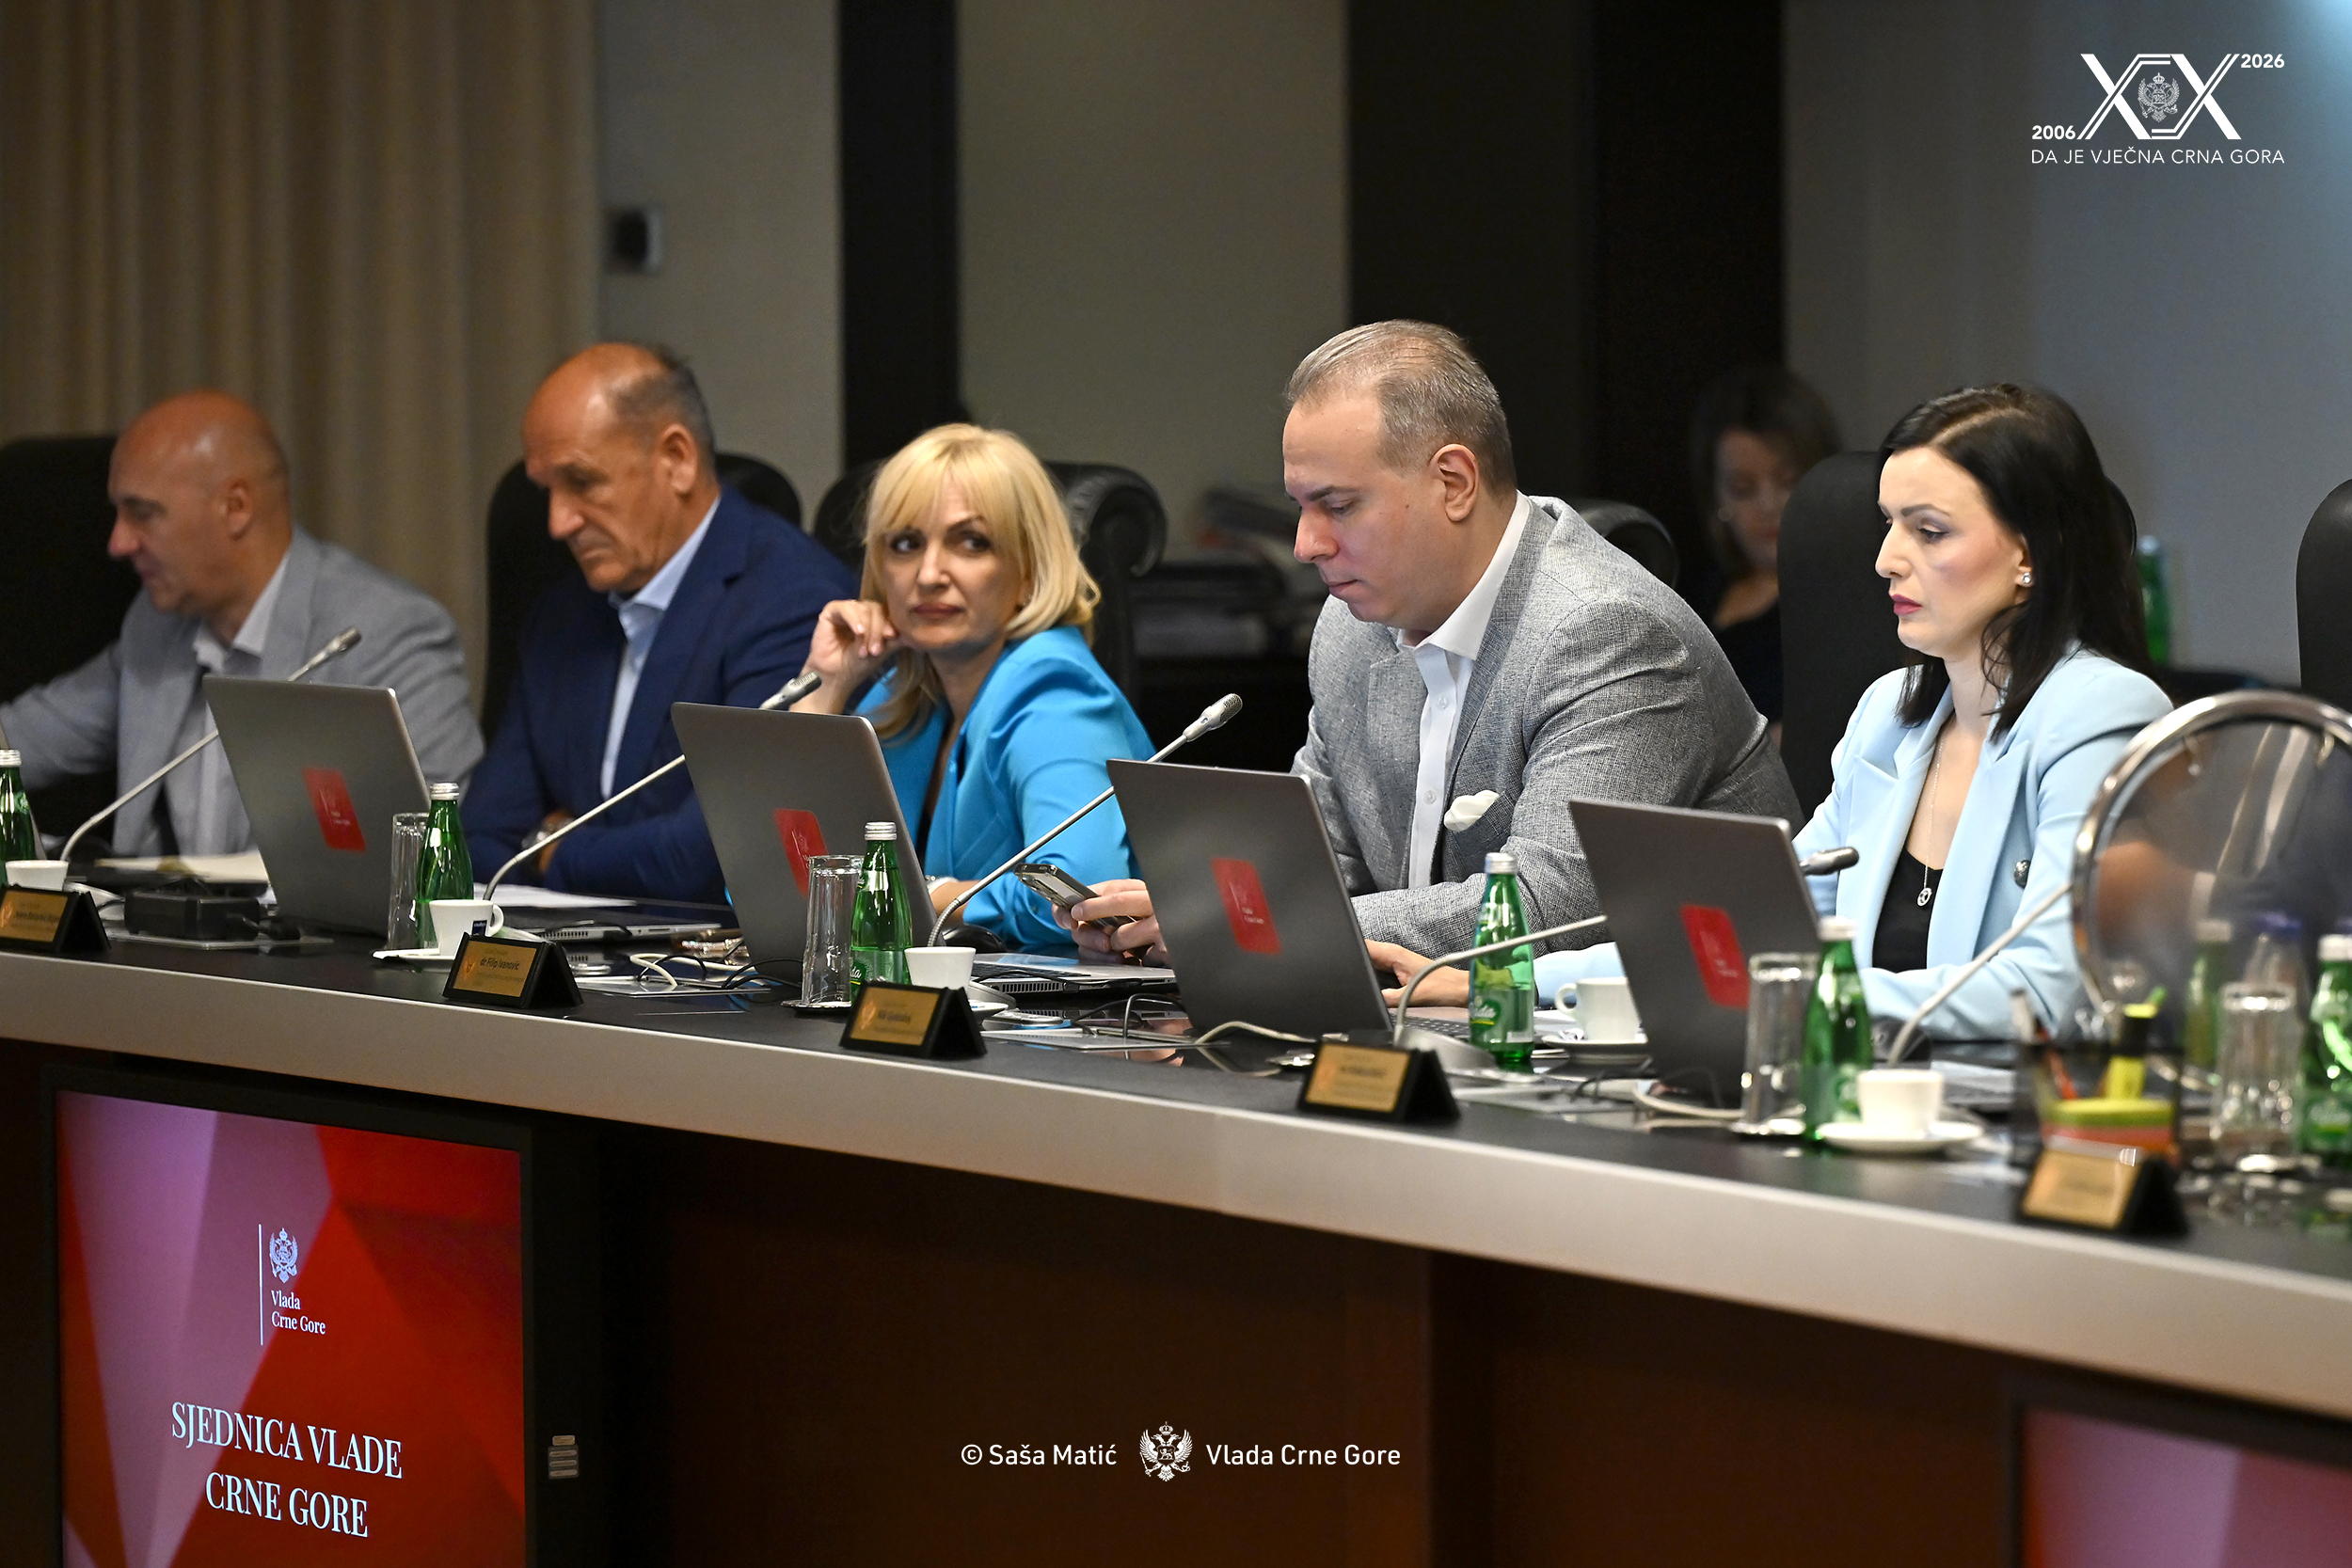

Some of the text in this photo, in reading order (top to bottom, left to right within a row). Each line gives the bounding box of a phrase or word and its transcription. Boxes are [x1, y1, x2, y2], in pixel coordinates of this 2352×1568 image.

[270, 1290, 301, 1310] Vlada
[271, 1310, 326, 1335] Crne Gore
[171, 1402, 403, 1480] SJEDNICA VLADE
[205, 1471, 368, 1538] CRNE GORE
